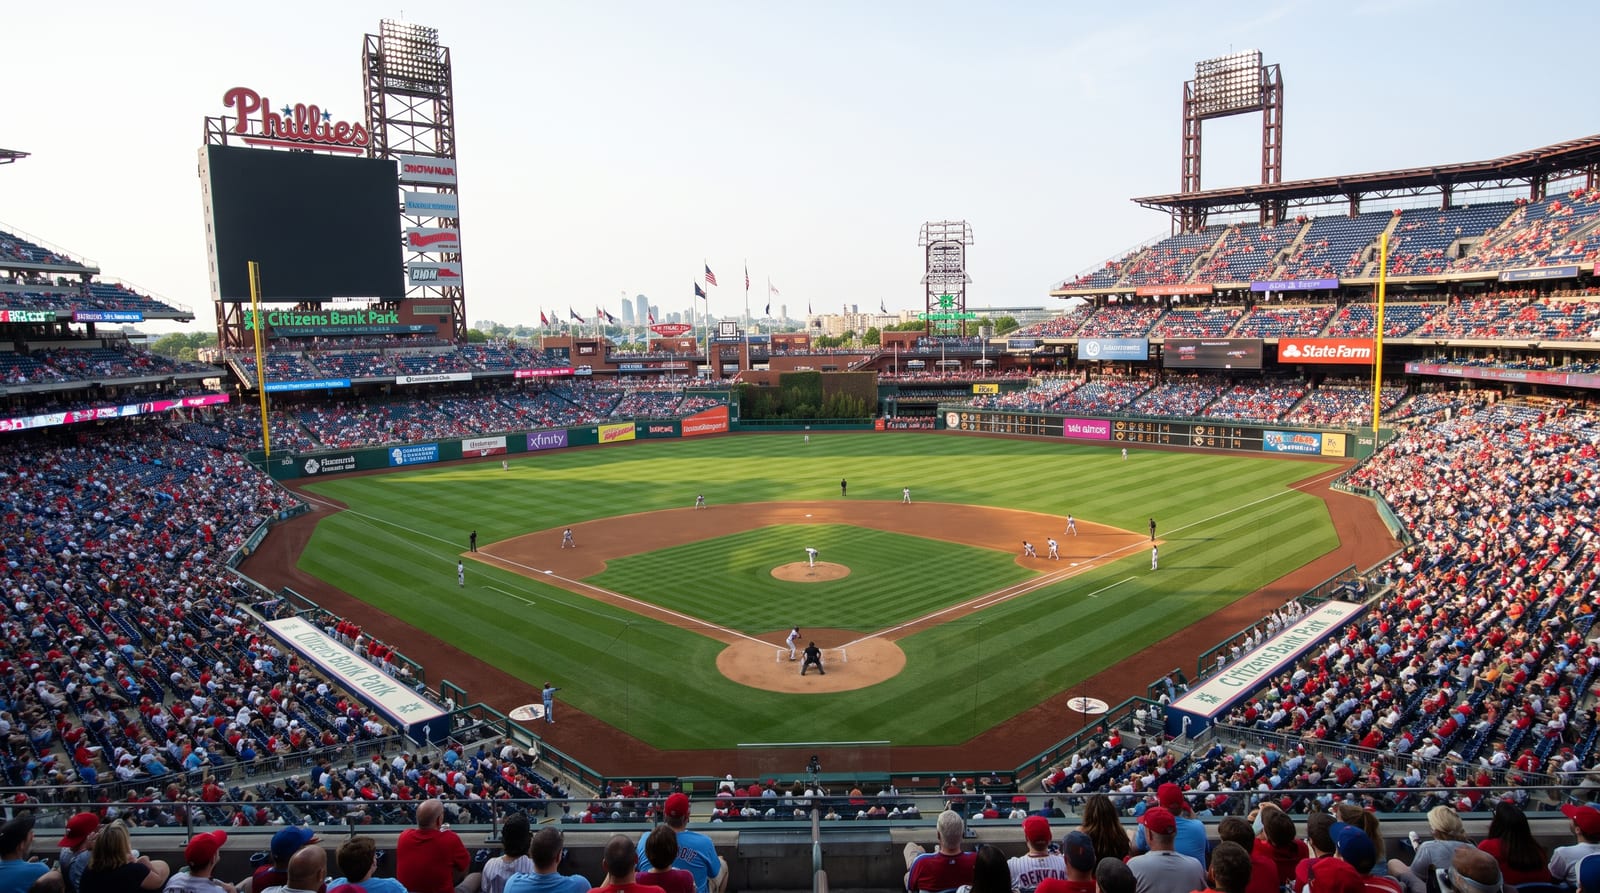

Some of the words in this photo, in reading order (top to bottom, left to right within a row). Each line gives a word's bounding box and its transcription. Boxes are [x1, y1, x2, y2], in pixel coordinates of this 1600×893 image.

[223, 87, 369, 146] Phillies
[268, 312, 328, 327] Citizens
[330, 311, 366, 325] Bank
[368, 310, 399, 324] Park
[530, 434, 565, 449] xfinity
[294, 631, 338, 663] Citizens
[330, 655, 366, 679] Bank
[357, 674, 397, 698] Park
[1219, 653, 1281, 688] Citizens
[1266, 636, 1309, 655] Bank
[1293, 619, 1331, 640] Park
